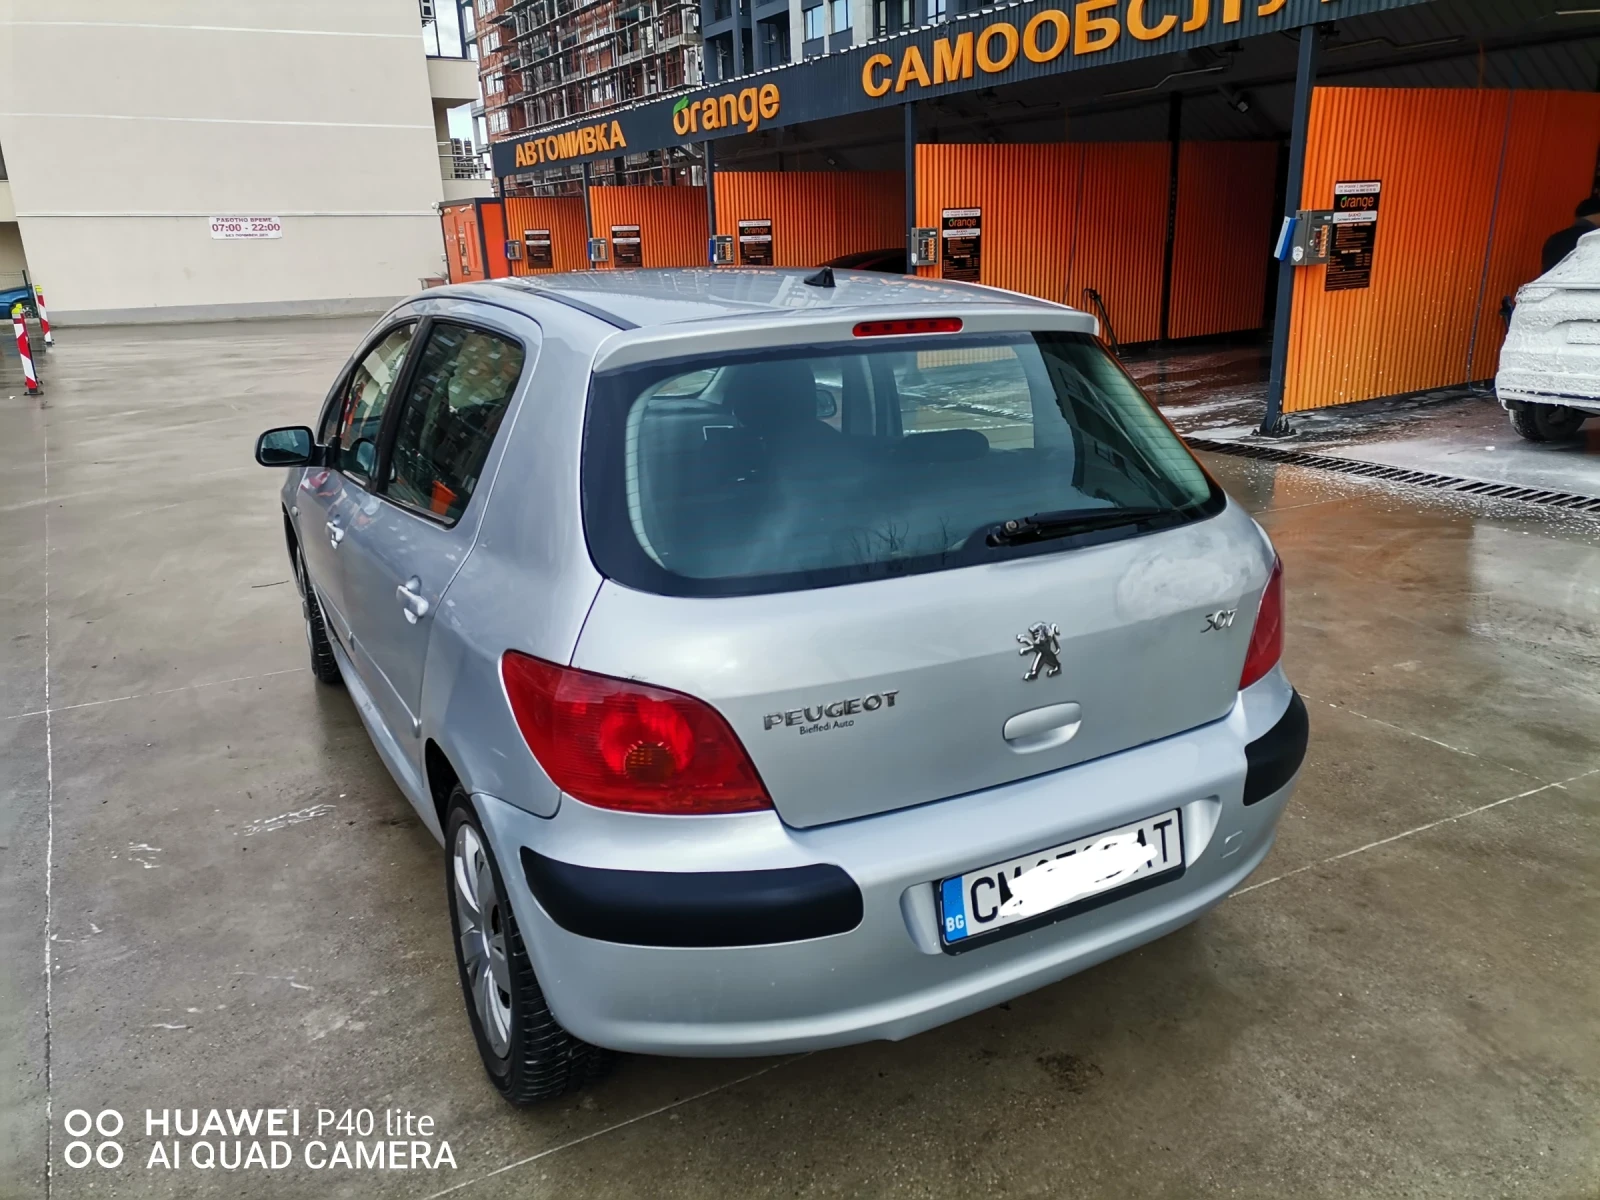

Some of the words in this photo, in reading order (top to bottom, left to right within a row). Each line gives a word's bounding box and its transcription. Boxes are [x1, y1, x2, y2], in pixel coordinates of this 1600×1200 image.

[673, 83, 780, 136] orange
[515, 120, 627, 168] АВТОМИВКА
[1340, 196, 1374, 210] orange
[211, 223, 242, 232] 07:00
[251, 223, 280, 231] 22:00
[949, 218, 977, 228] orange
[763, 690, 900, 731] PEUGEOT
[833, 719, 855, 729] Auto
[945, 914, 965, 932] BG
